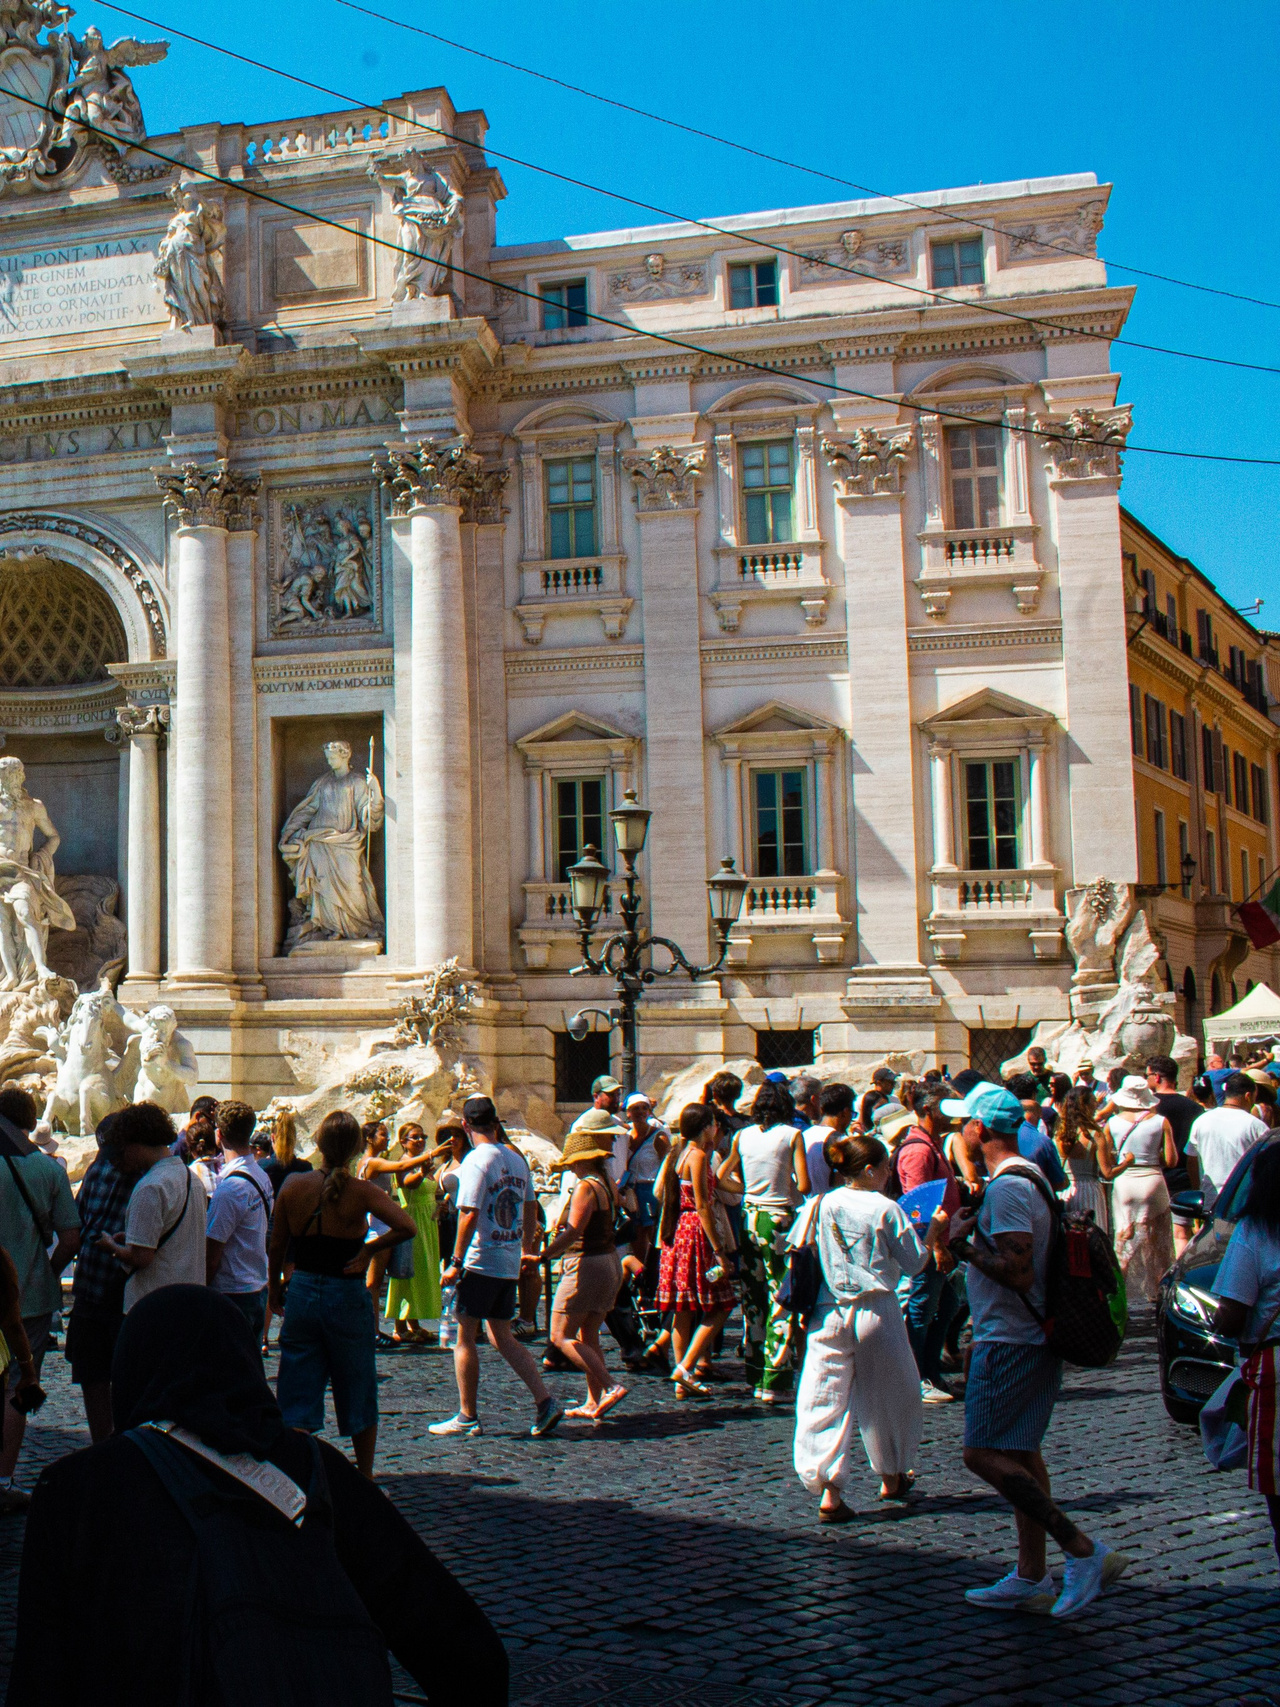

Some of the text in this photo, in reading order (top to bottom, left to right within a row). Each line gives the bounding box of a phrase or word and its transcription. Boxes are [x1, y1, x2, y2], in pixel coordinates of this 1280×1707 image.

[16, 266, 86, 287] VIRGINEM
[47, 272, 157, 297] COMMENDATAM
[58, 292, 123, 311] ORNAVIT
[105, 420, 166, 451] XIV
[321, 395, 401, 428] MAX
